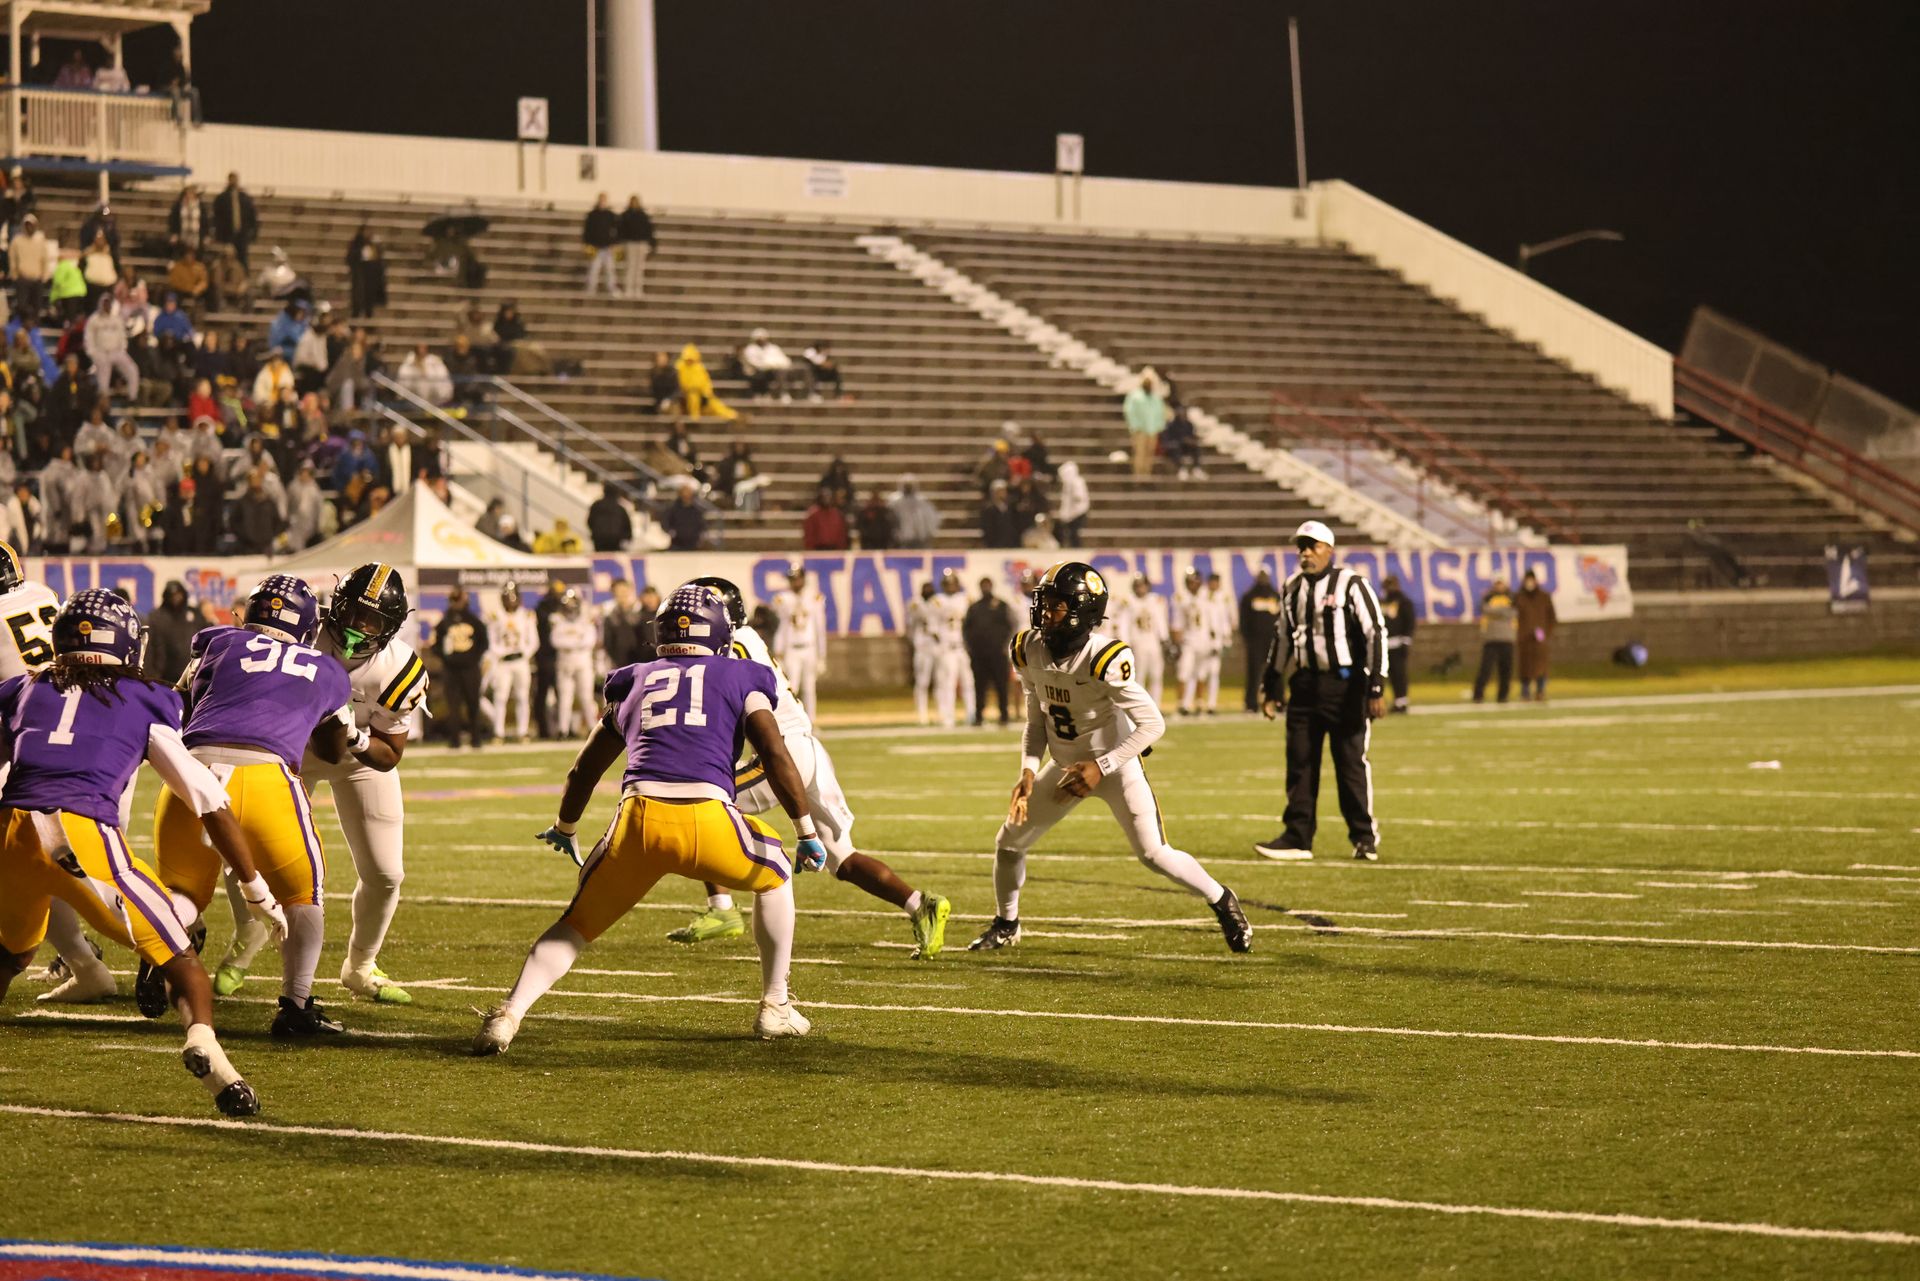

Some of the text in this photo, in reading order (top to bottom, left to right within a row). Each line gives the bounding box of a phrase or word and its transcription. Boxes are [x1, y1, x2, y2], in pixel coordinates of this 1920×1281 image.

[523, 102, 543, 131] X
[486, 569, 510, 586] High
[512, 569, 549, 584] School
[1086, 550, 1558, 622] CHAMONSHIP
[357, 596, 380, 609] Riddell
[679, 629, 687, 638] 21
[240, 633, 322, 682] 92
[1120, 660, 1132, 682] 8
[641, 664, 708, 735] 21
[1044, 685, 1071, 703] IRMO
[47, 684, 84, 745] 1
[1048, 704, 1079, 741] 8
